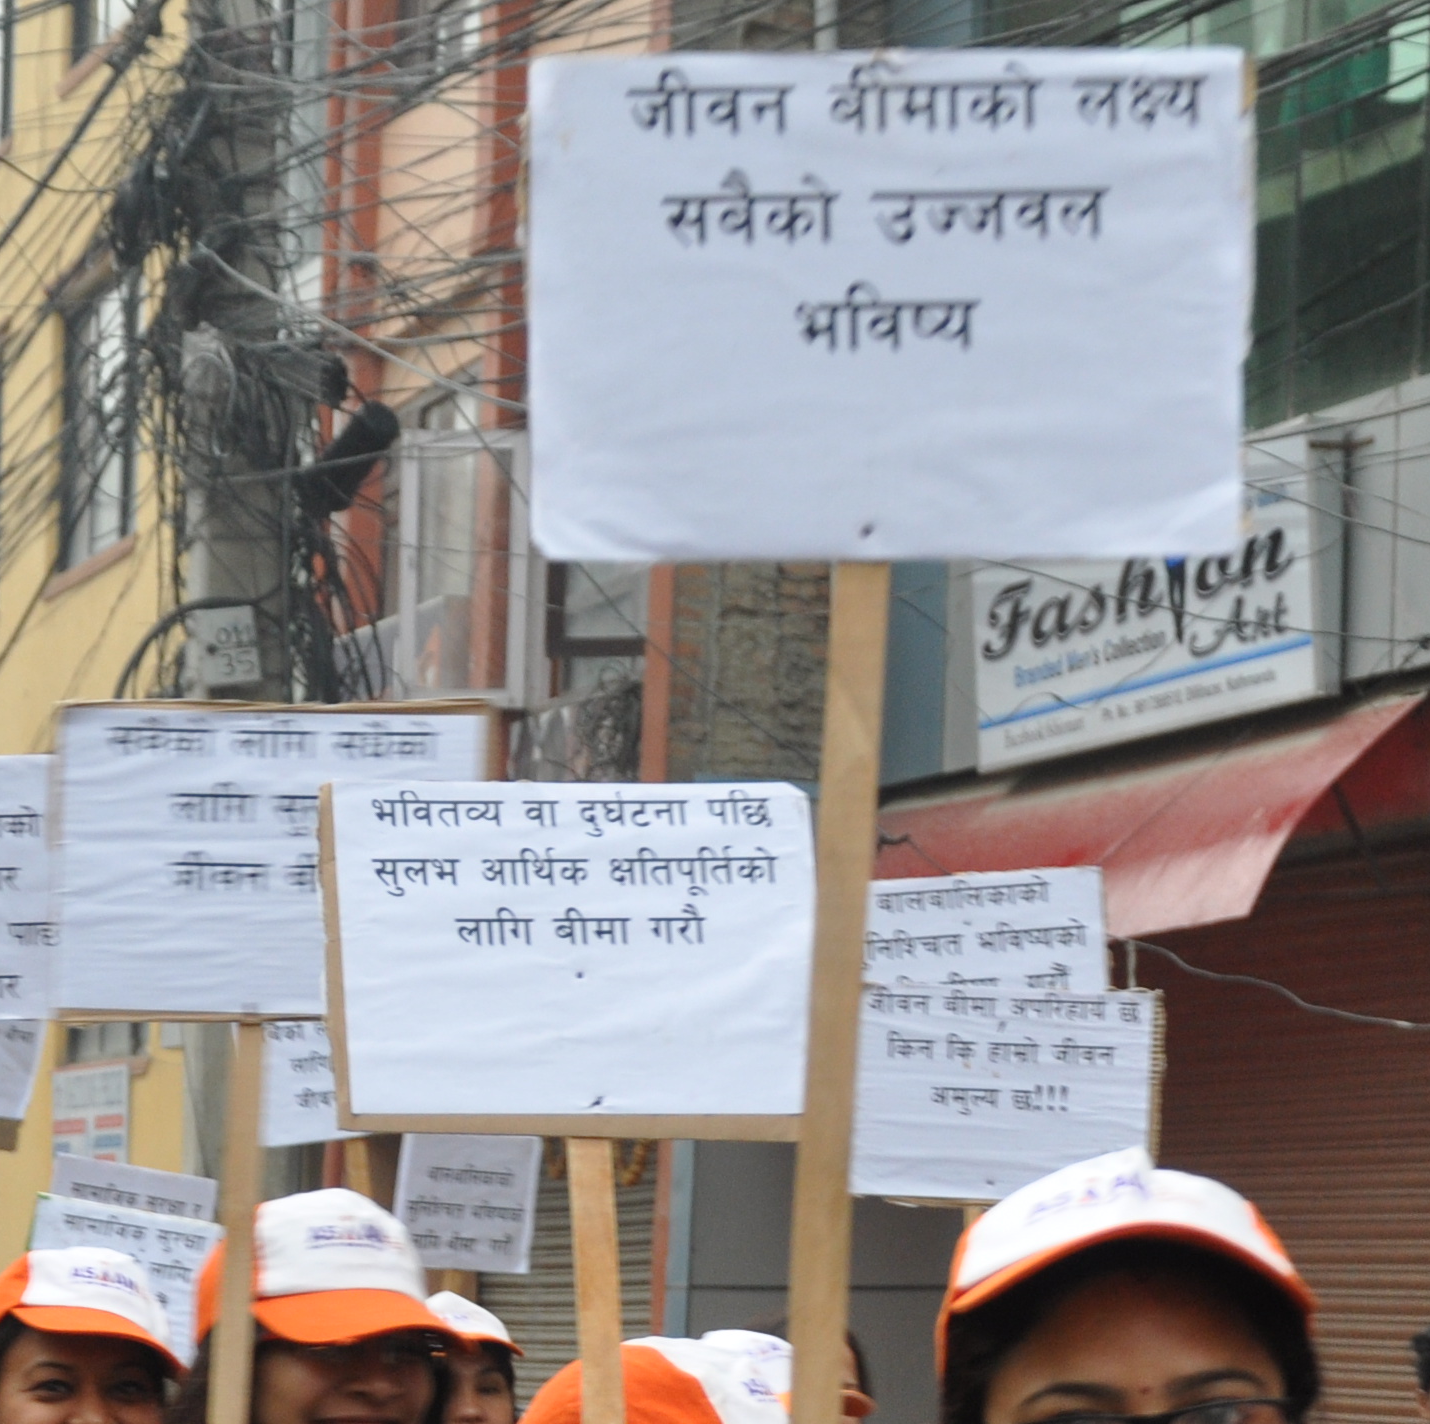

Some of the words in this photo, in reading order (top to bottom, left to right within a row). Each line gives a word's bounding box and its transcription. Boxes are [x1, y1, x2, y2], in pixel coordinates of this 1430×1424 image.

[626, 66, 795, 136] जीवन
[1072, 74, 1209, 130] लक्ष्य
[869, 184, 1111, 246] उज्जवल
[794, 282, 982, 353] भविष्य
[1188, 591, 1291, 659] Art
[371, 789, 505, 828] भवितव्य
[521, 797, 559, 828] वा
[705, 789, 775, 830] पछि
[371, 857, 461, 897] सुलभ
[480, 847, 589, 888] आर्थिक
[455, 907, 535, 948] लागि
[552, 907, 632, 948] बीमा
